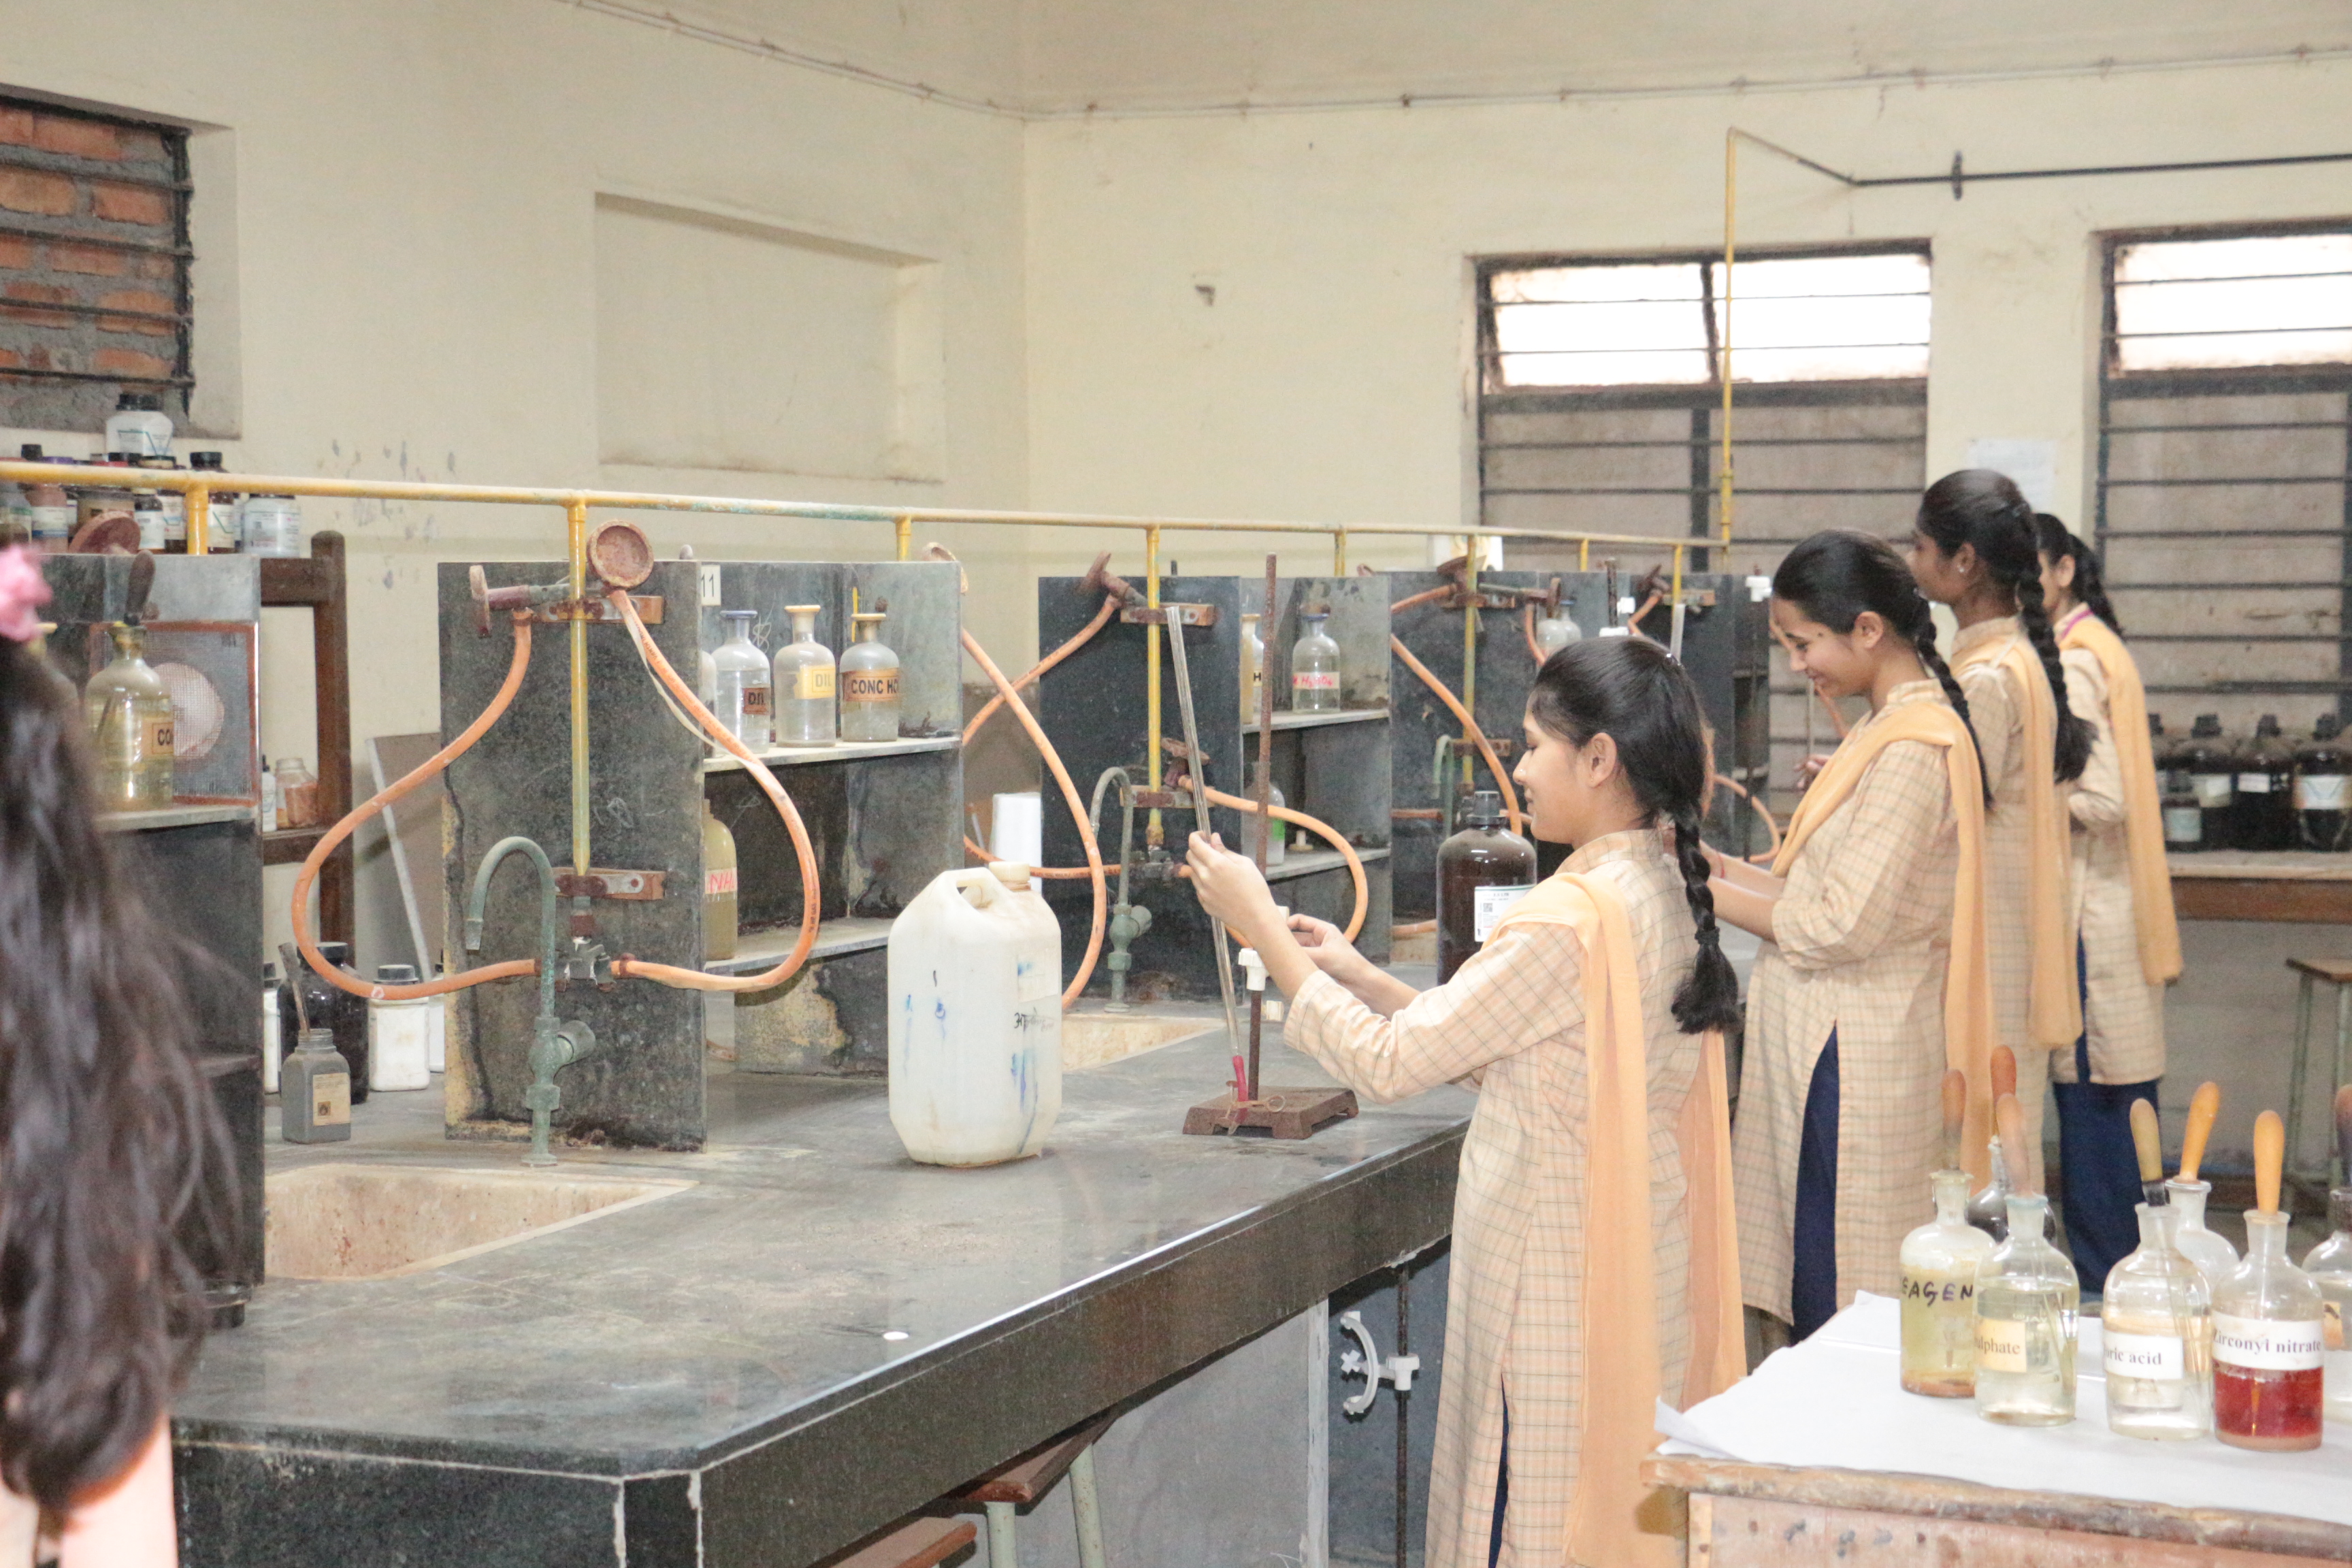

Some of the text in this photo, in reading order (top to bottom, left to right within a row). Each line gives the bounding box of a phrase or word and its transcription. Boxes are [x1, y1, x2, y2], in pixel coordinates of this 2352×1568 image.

[700, 573, 714, 598] 11
[851, 679, 883, 694] CONC
[1974, 1335, 2021, 1355] ulphate
[2213, 1327, 2321, 1355] Zirconyl nitrate
[2129, 1352, 2162, 1365] acid
